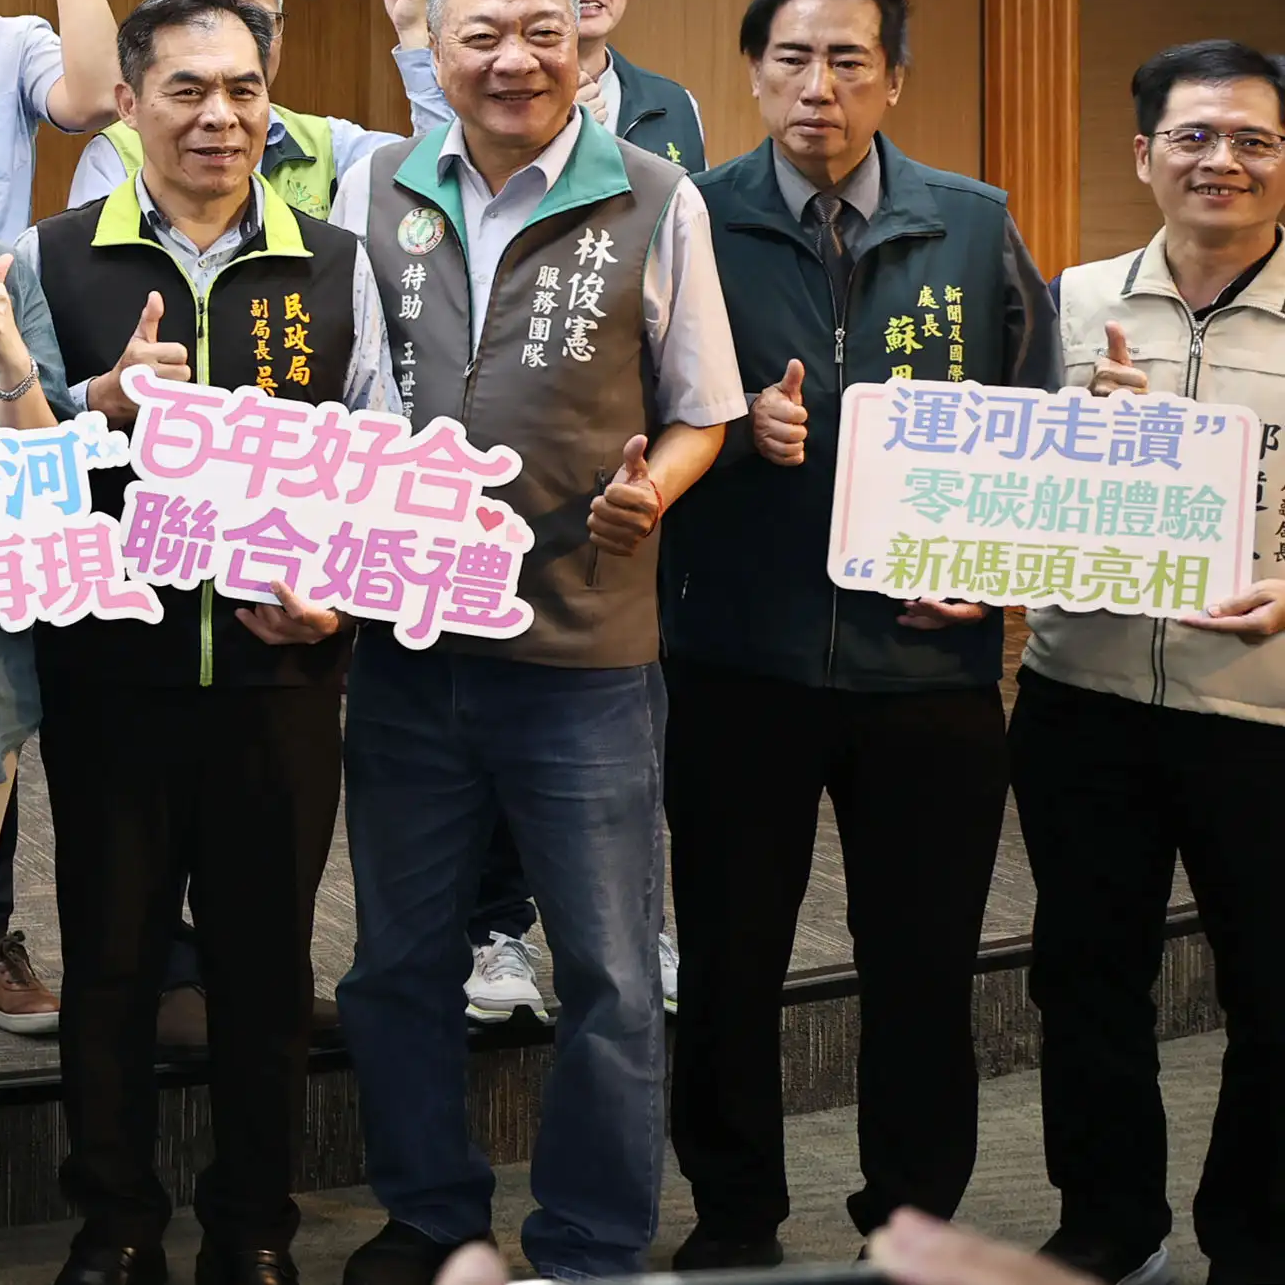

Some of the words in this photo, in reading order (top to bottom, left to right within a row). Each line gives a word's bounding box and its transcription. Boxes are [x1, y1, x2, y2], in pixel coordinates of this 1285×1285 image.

[283, 292, 314, 387] 民政局
[398, 263, 427, 320] 特助
[521, 265, 562, 368] 服務團隊
[562, 228, 619, 362] 林俊憲
[917, 284, 943, 337] 處長
[131, 374, 513, 523] 百年好合
[899, 466, 1228, 543] 零碳船體驗
[121, 490, 524, 640] 聯合婚禮
